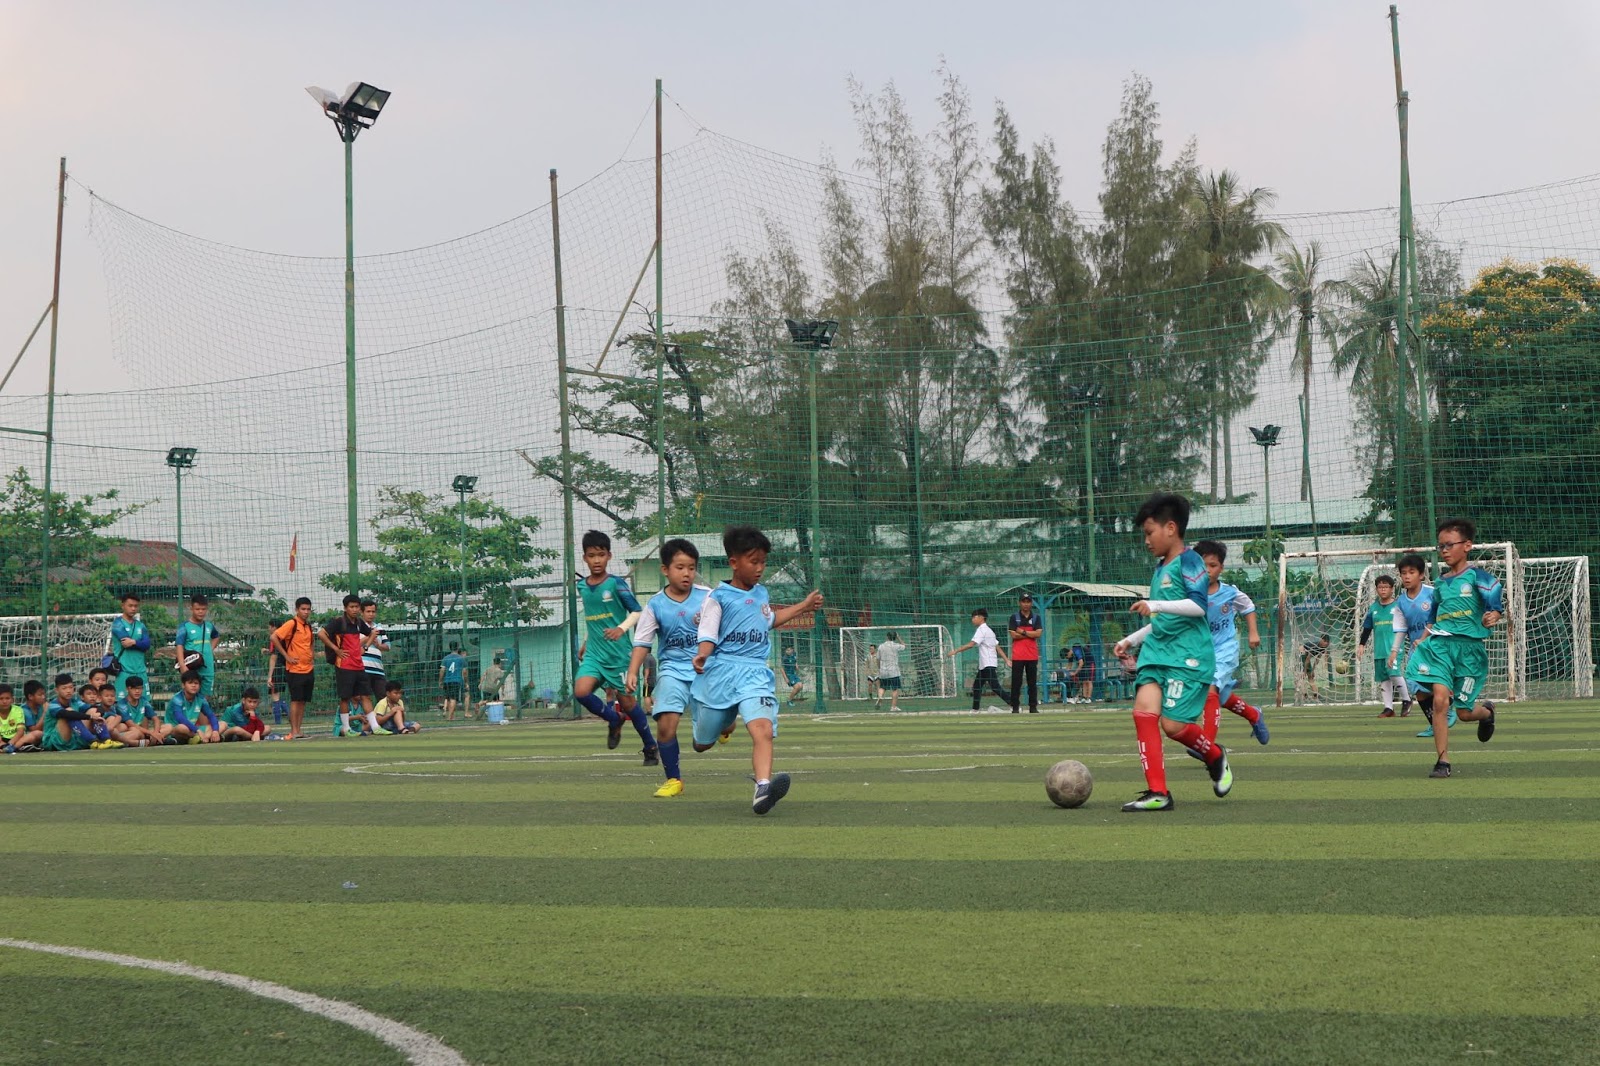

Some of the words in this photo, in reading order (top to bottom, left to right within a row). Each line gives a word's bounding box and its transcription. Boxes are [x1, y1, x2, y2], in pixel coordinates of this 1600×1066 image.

[749, 629, 762, 643] Gia
[448, 661, 456, 674] 4
[1166, 678, 1184, 699] 10
[1461, 676, 1476, 695] 10
